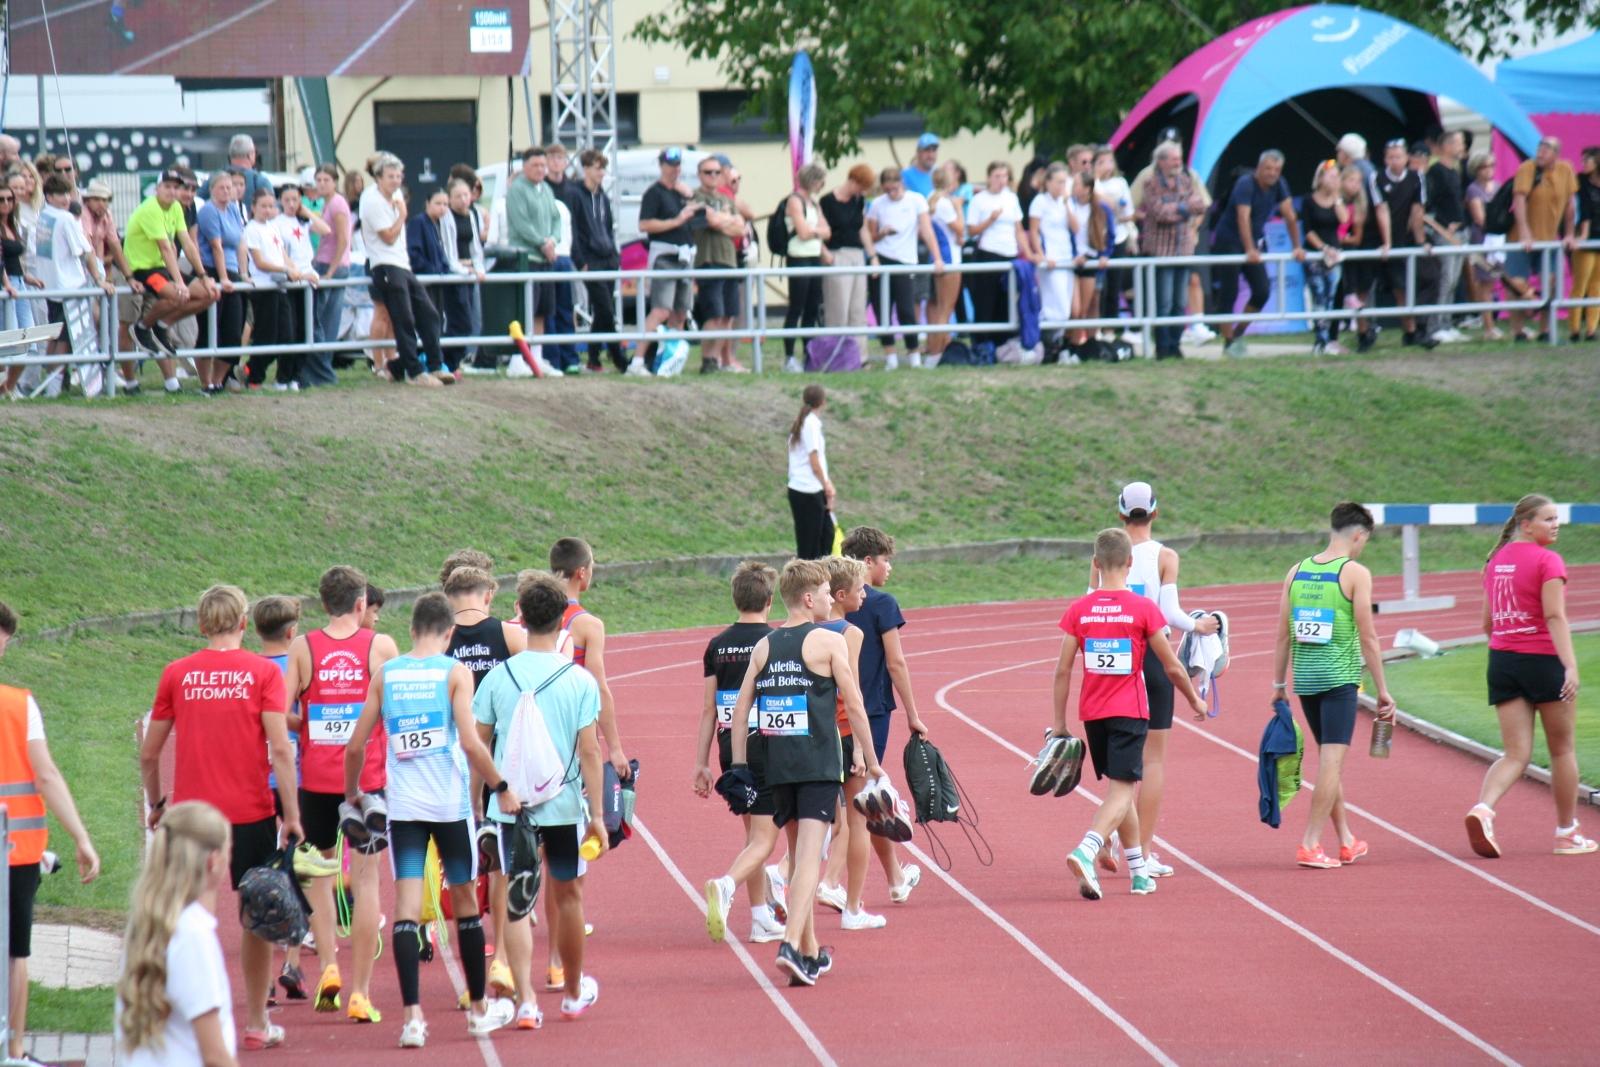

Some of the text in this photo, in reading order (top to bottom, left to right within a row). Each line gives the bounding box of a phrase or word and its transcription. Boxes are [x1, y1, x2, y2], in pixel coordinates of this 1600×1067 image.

[1298, 623, 1320, 636] 452
[453, 643, 490, 658] Atletika
[727, 646, 754, 655] SPART
[768, 661, 802, 673] Atletika
[1097, 654, 1115, 668] 52
[181, 671, 254, 686] ATLETIKA
[184, 685, 250, 700] LITOMYŠL
[392, 683, 436, 691] ATLETIKA
[722, 693, 739, 701] ČESK
[766, 698, 785, 706] ČESKÁ
[322, 706, 344, 714] ČESKÁ
[397, 715, 420, 727] ČESKÁ
[766, 713, 795, 728] 264
[324, 721, 351, 733] 497
[399, 731, 432, 750] 185
